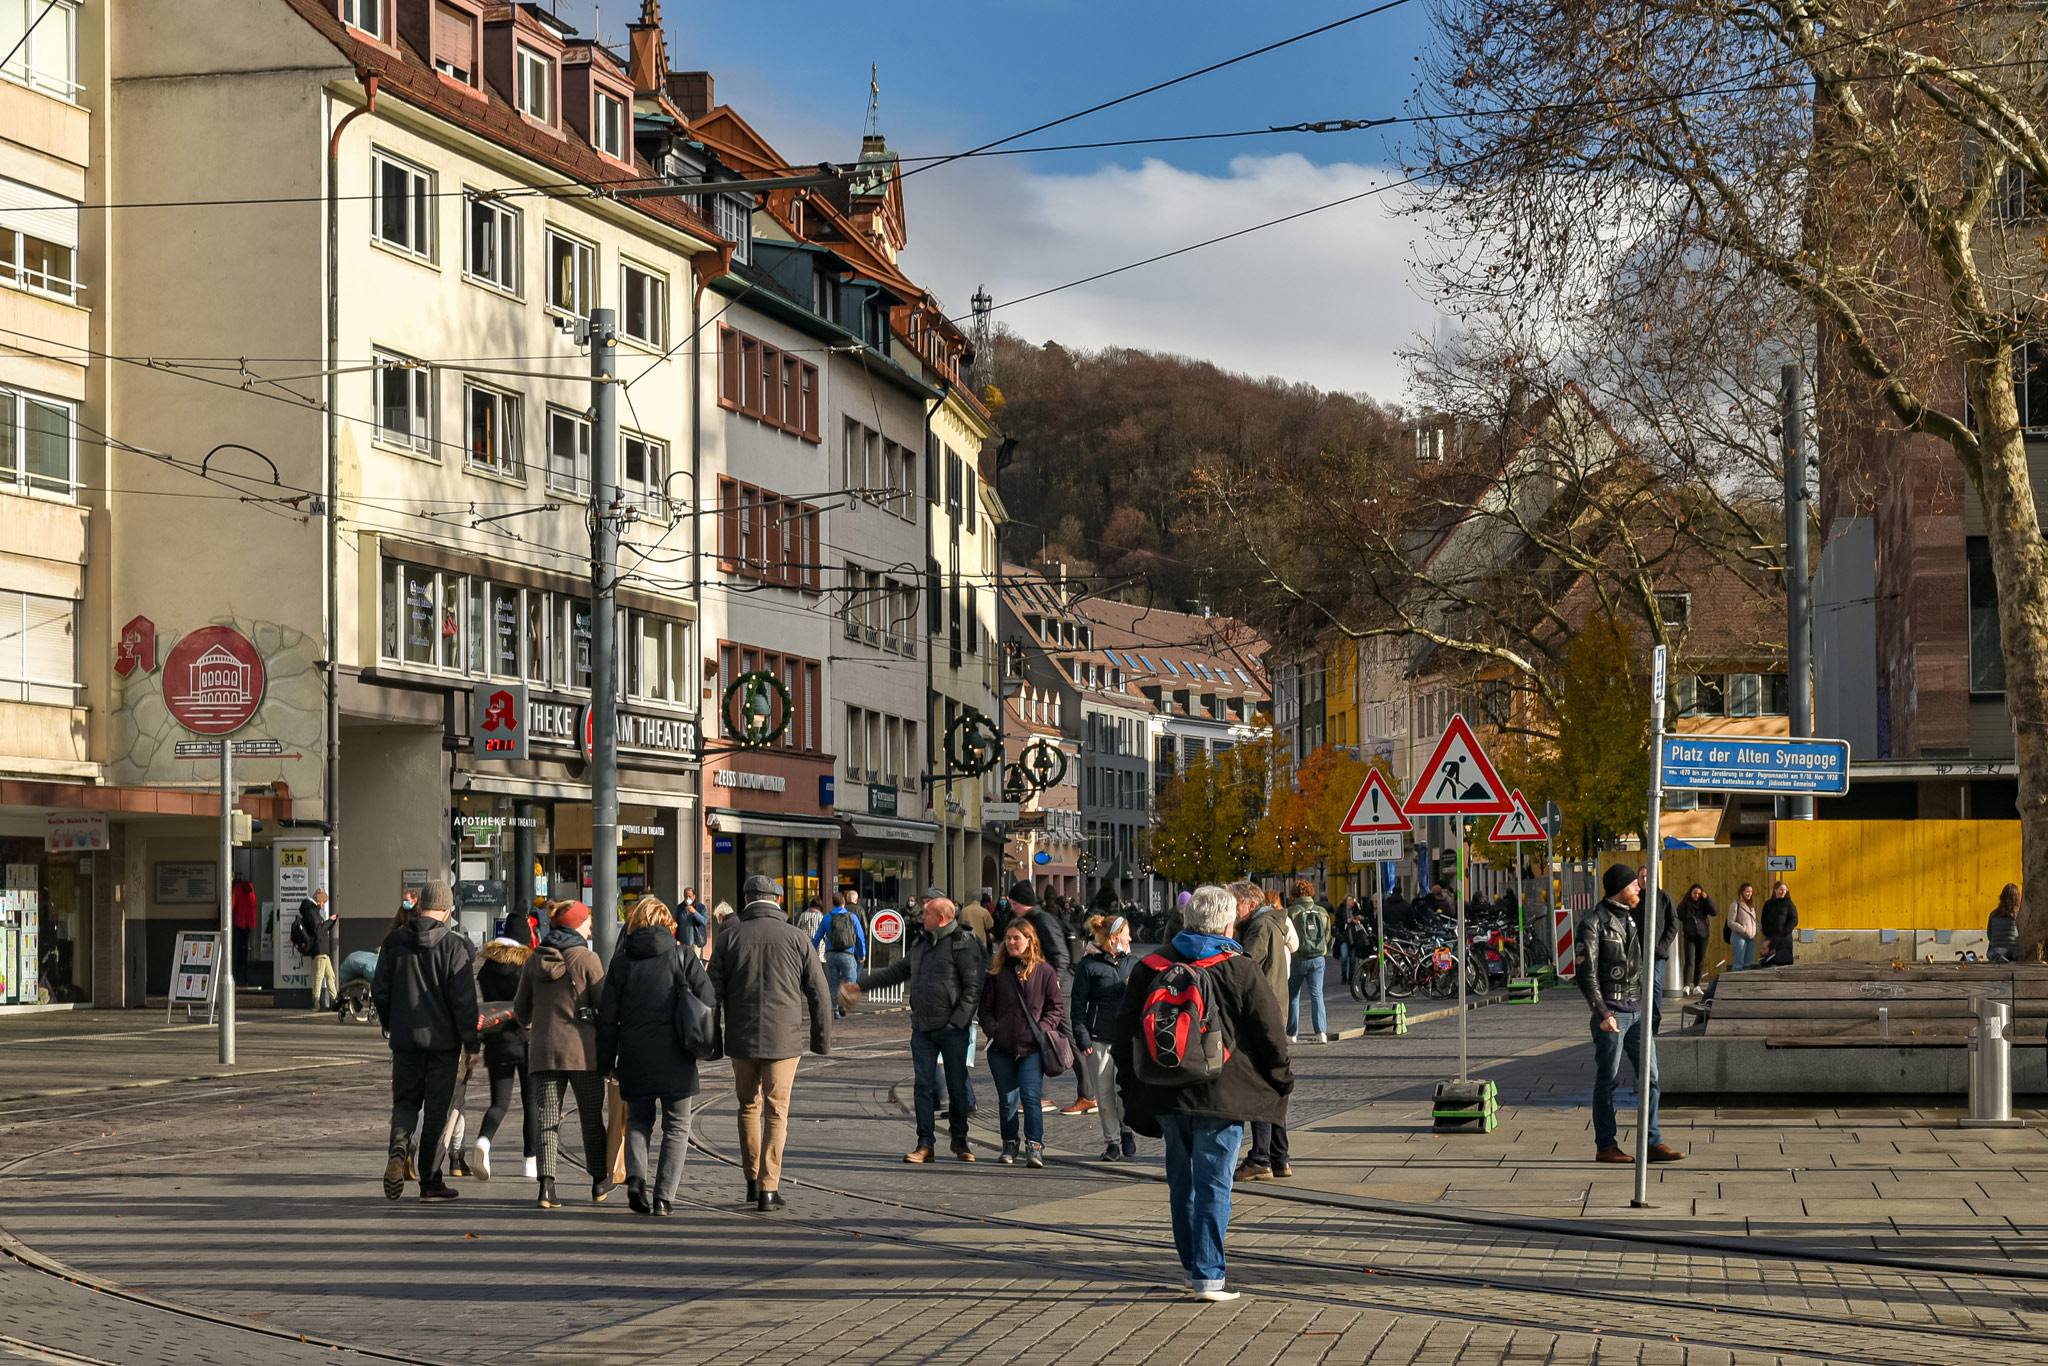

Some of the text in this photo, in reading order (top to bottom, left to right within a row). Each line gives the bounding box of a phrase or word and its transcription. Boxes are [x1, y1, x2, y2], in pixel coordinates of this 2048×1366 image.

[312, 504, 323, 513] VA
[639, 718, 695, 750] THEATER
[1672, 746, 1837, 770] Platz der Alten Synagoge
[718, 770, 736, 787] ZEISS
[763, 775, 786, 792] CENTER
[454, 816, 506, 826] APOTHEKE
[509, 817, 516, 826] AM
[518, 818, 536, 828] THEATER
[1358, 836, 1399, 846] Baustellen-
[1362, 848, 1392, 858] ausfahrt
